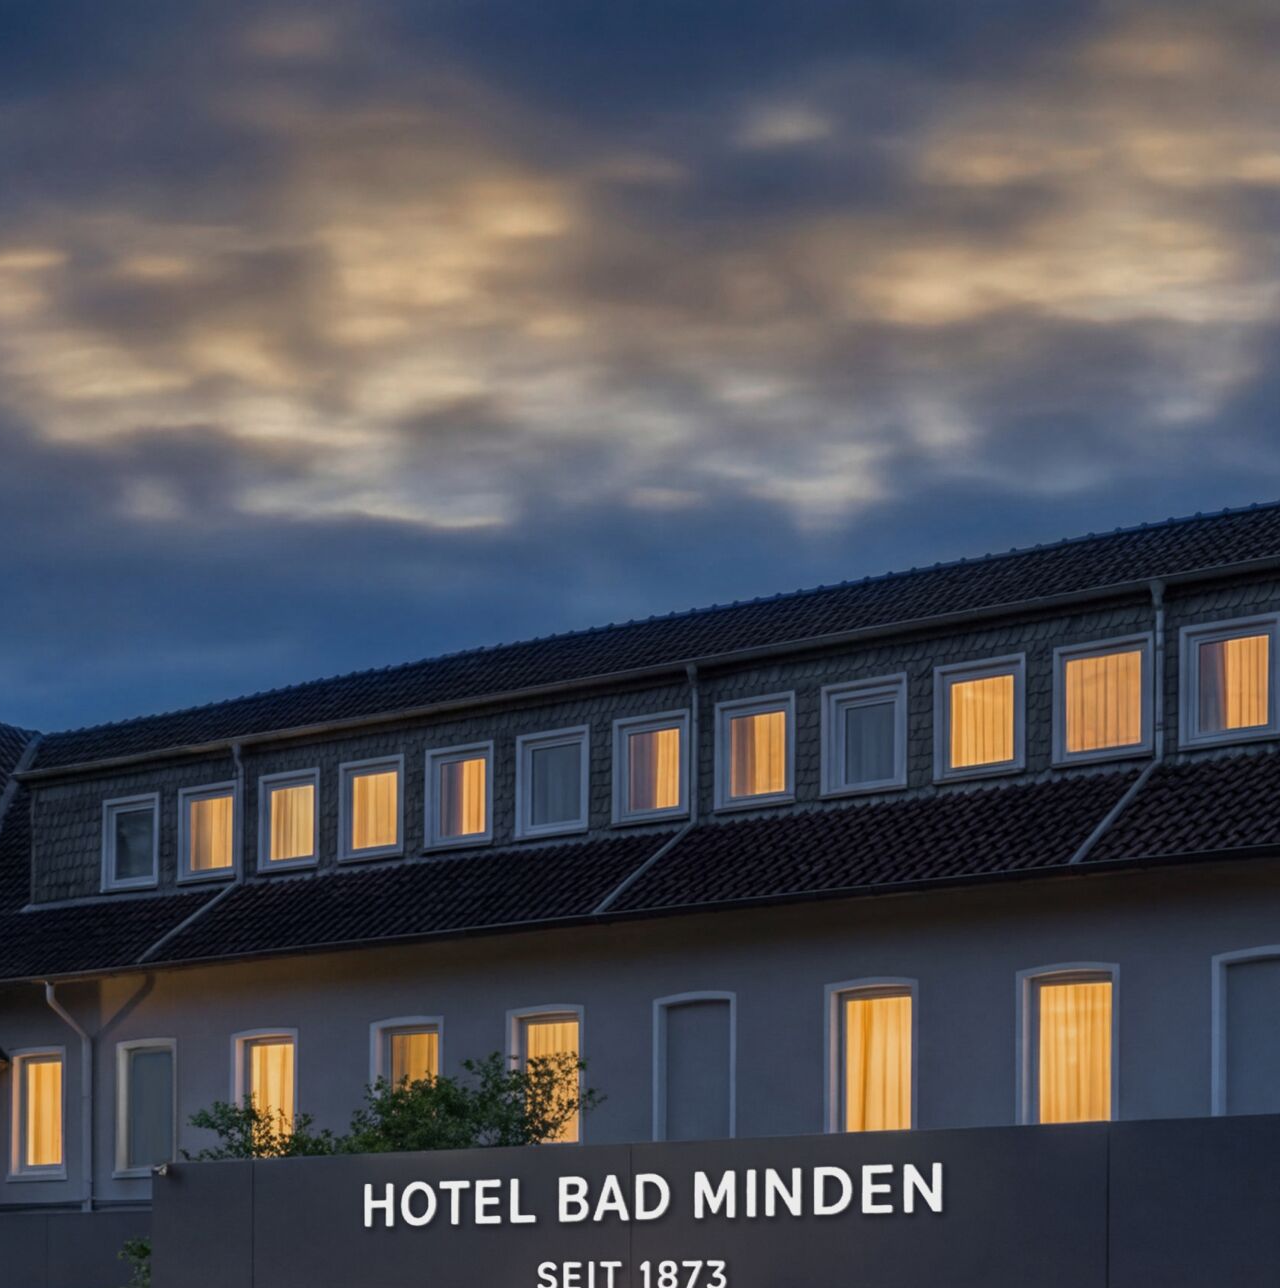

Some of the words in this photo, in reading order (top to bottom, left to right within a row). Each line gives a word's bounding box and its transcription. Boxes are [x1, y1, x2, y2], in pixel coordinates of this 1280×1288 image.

[363, 1178, 536, 1227] HOTEL
[558, 1173, 671, 1222] BAD
[693, 1162, 944, 1219] MINDEN
